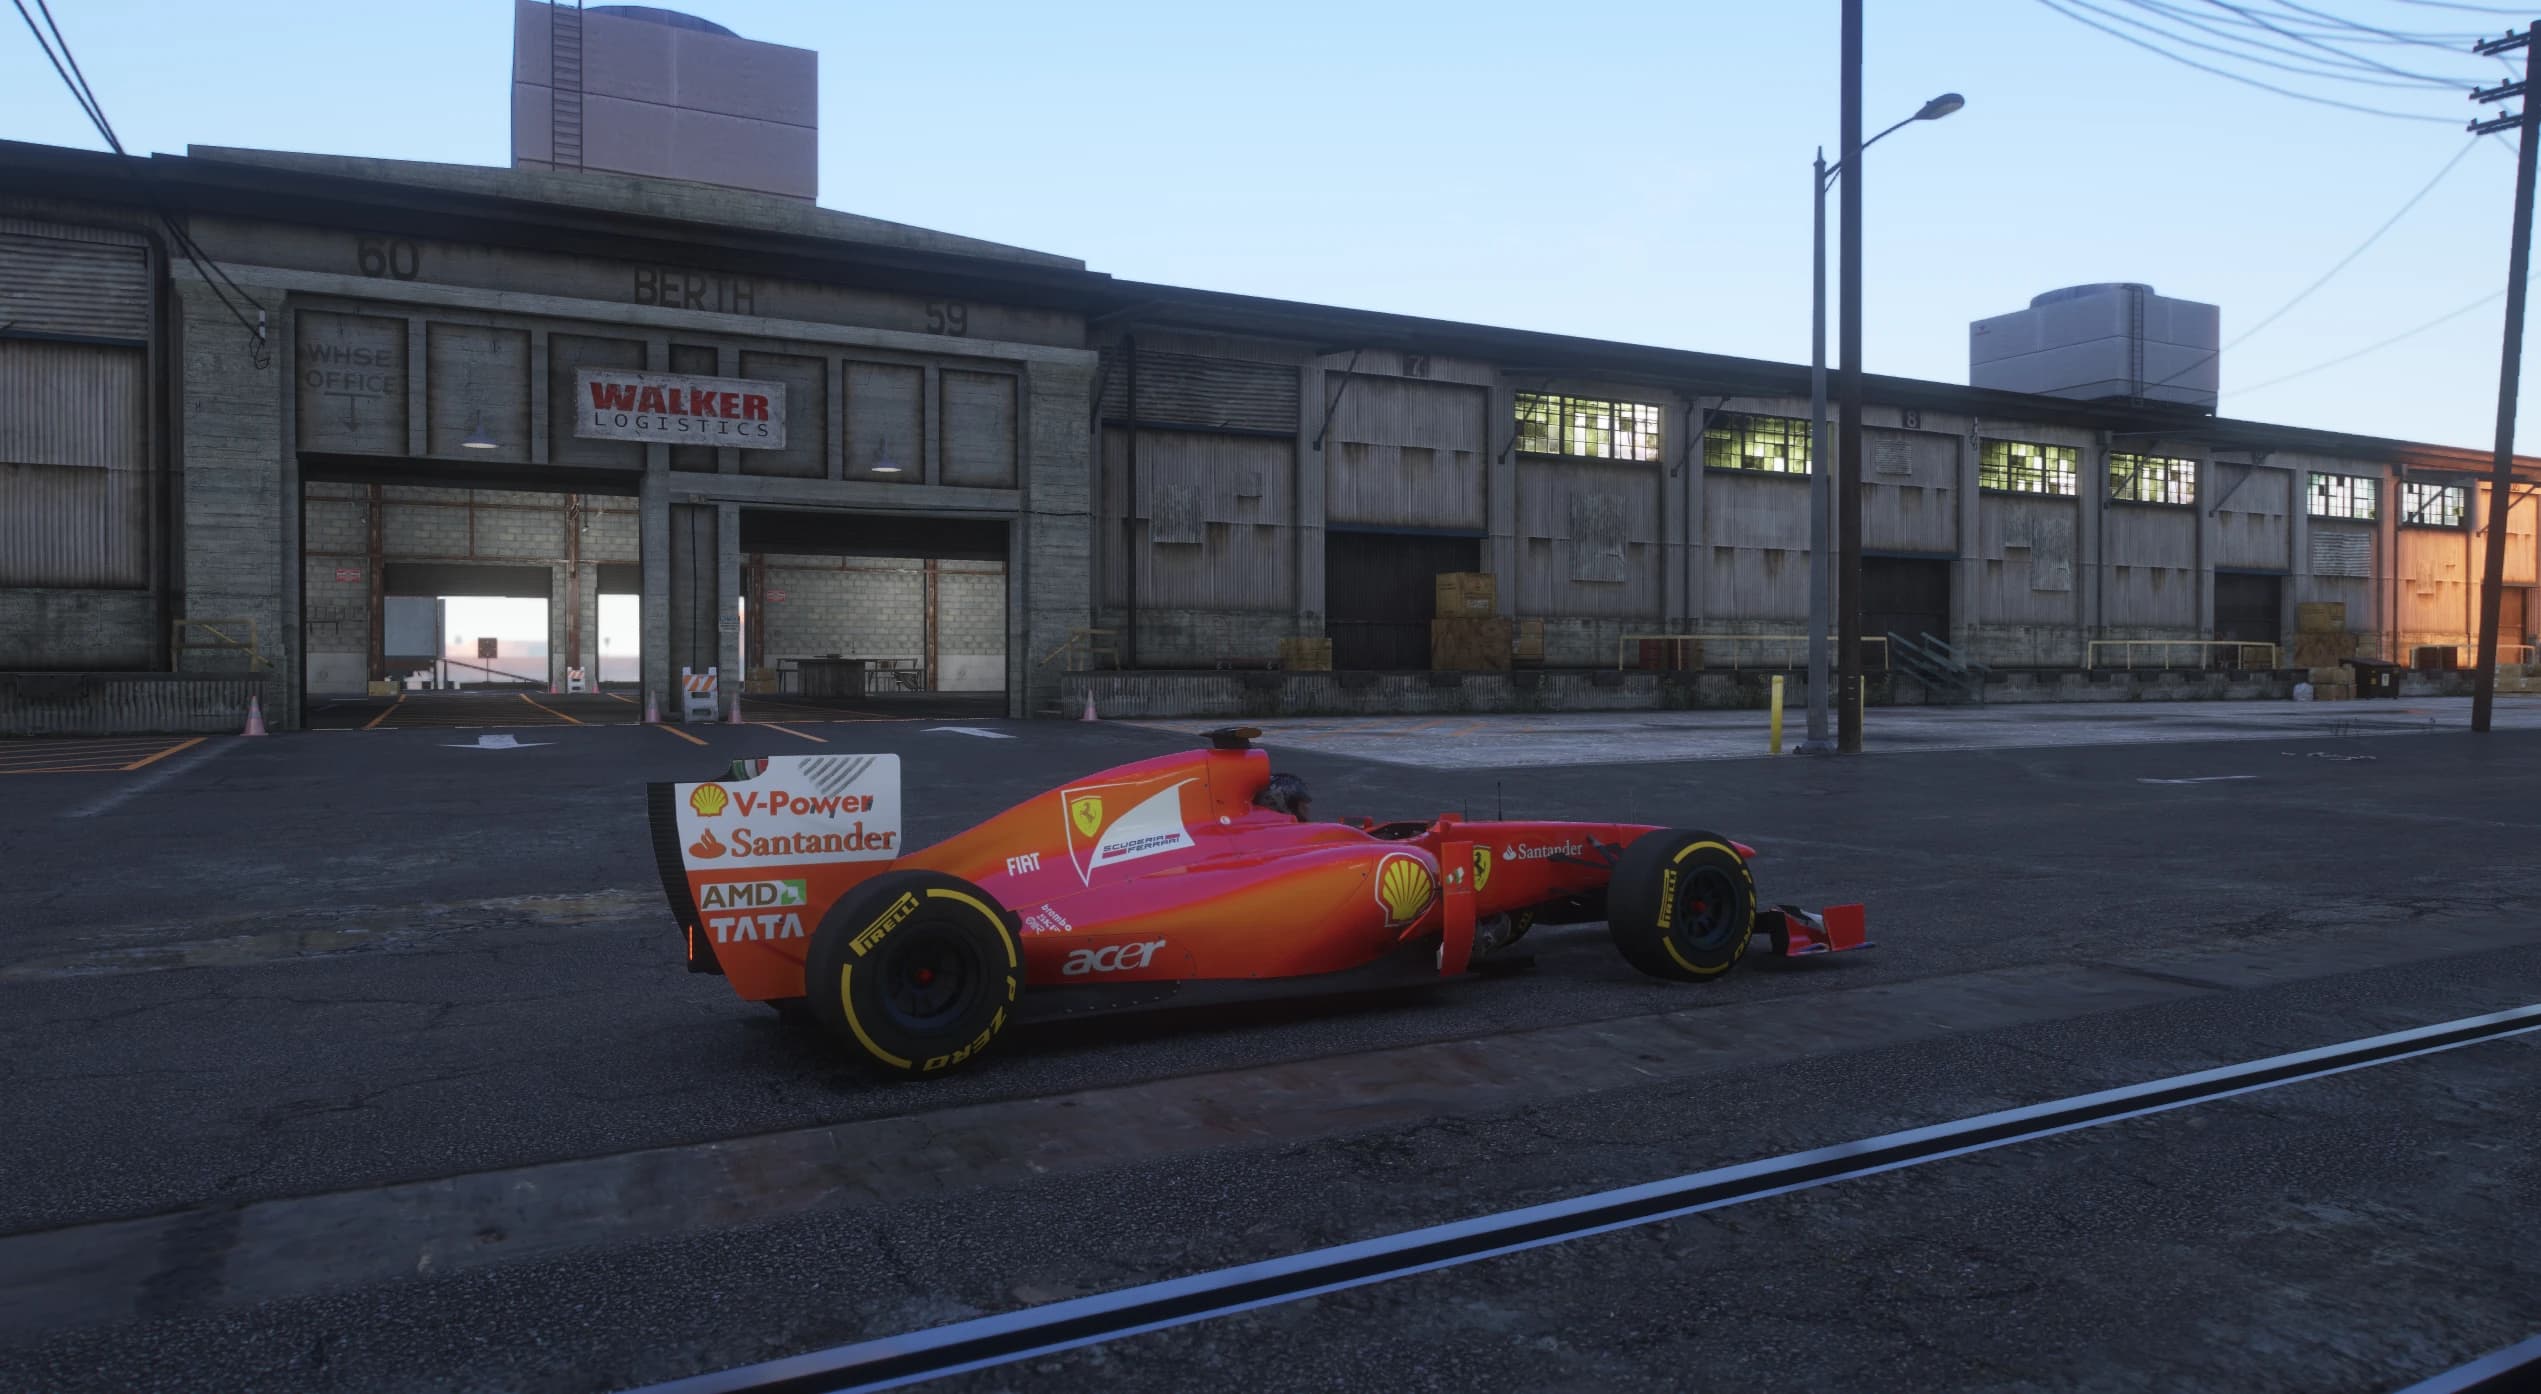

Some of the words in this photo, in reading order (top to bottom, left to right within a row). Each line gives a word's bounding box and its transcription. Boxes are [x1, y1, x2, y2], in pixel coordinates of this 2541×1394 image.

[357, 237, 420, 281] 60
[634, 266, 754, 315] BERTH
[926, 302, 968, 337] 59
[306, 343, 395, 368] WHSE
[306, 369, 397, 393] OFFICE
[590, 382, 768, 421] WALKER
[595, 412, 768, 437] LOGISTICS
[733, 791, 874, 817] V-Power
[731, 821, 896, 858] Santander
[1103, 834, 1164, 851] SCUDERIA
[1127, 837, 1180, 853] FERRARI
[1518, 840, 1584, 859] Santander
[1006, 852, 1040, 876] FIAT
[702, 883, 778, 908] AMD
[1657, 868, 1677, 928] PIRELLI
[709, 912, 804, 943] TATA
[849, 891, 920, 957] PIRELLI
[1062, 939, 1166, 975] acer
[923, 1005, 1007, 1071] ZERO
